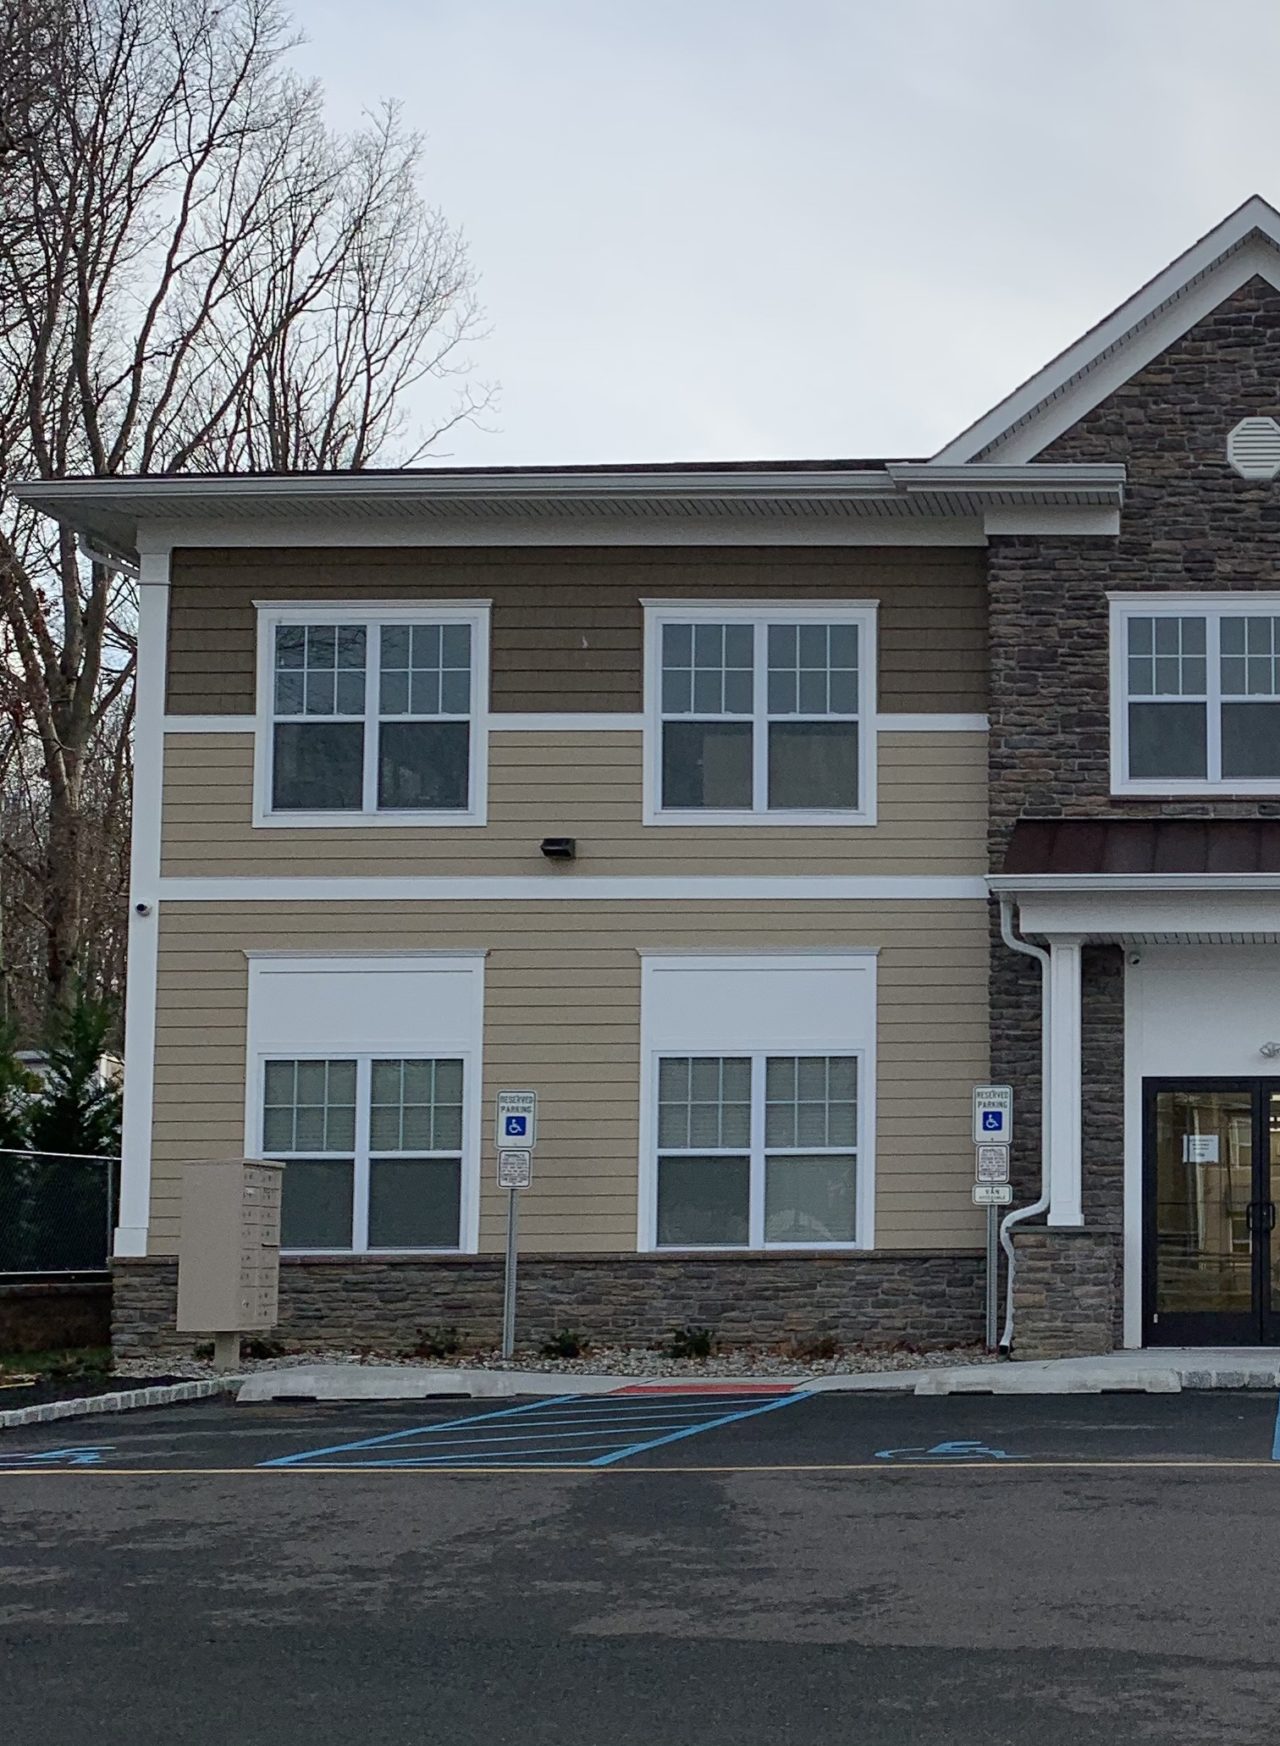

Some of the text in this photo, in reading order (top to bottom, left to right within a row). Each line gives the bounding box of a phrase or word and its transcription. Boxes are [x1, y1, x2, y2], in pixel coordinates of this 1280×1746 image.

[977, 1091, 1008, 1099] RESERVED
[500, 1095, 533, 1104] RESERVED
[977, 1101, 1008, 1109] PARKING
